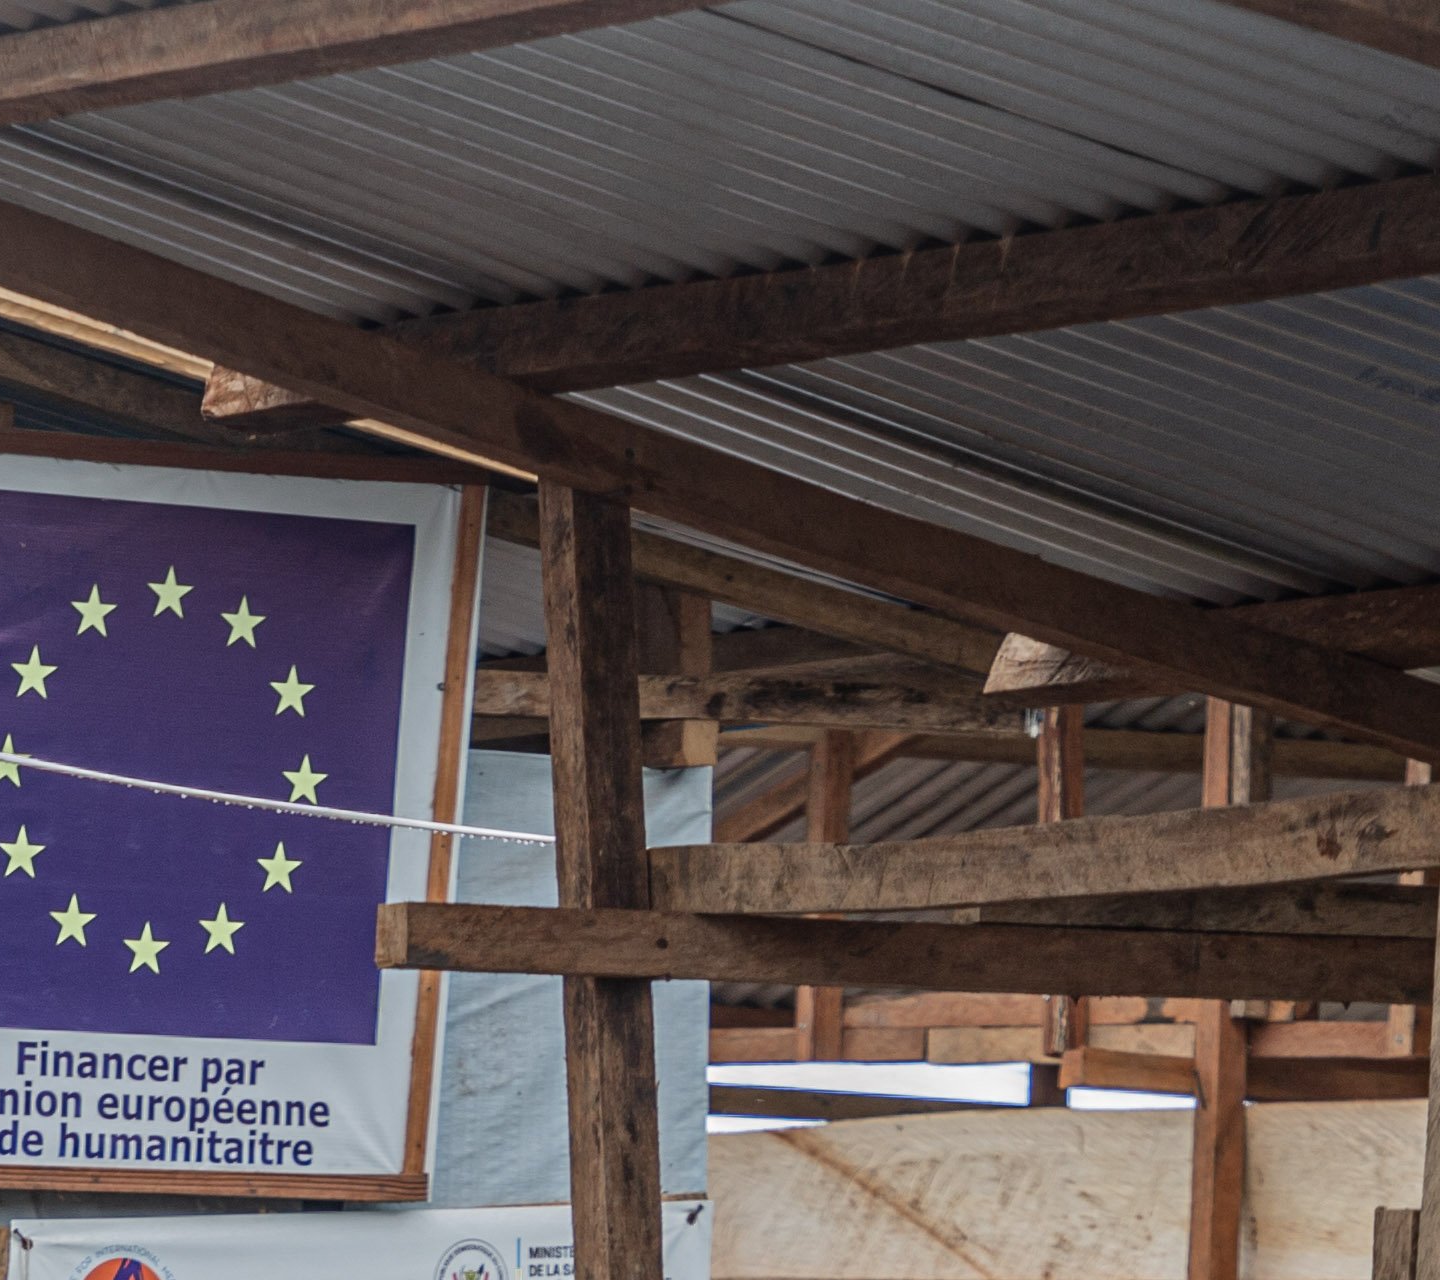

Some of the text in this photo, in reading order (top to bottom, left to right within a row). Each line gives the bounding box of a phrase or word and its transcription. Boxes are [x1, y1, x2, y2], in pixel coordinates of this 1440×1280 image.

[16, 1040, 266, 1093] Financer par
[96, 1087, 331, 1133] européenne
[58, 1123, 315, 1168] humanitaitre
